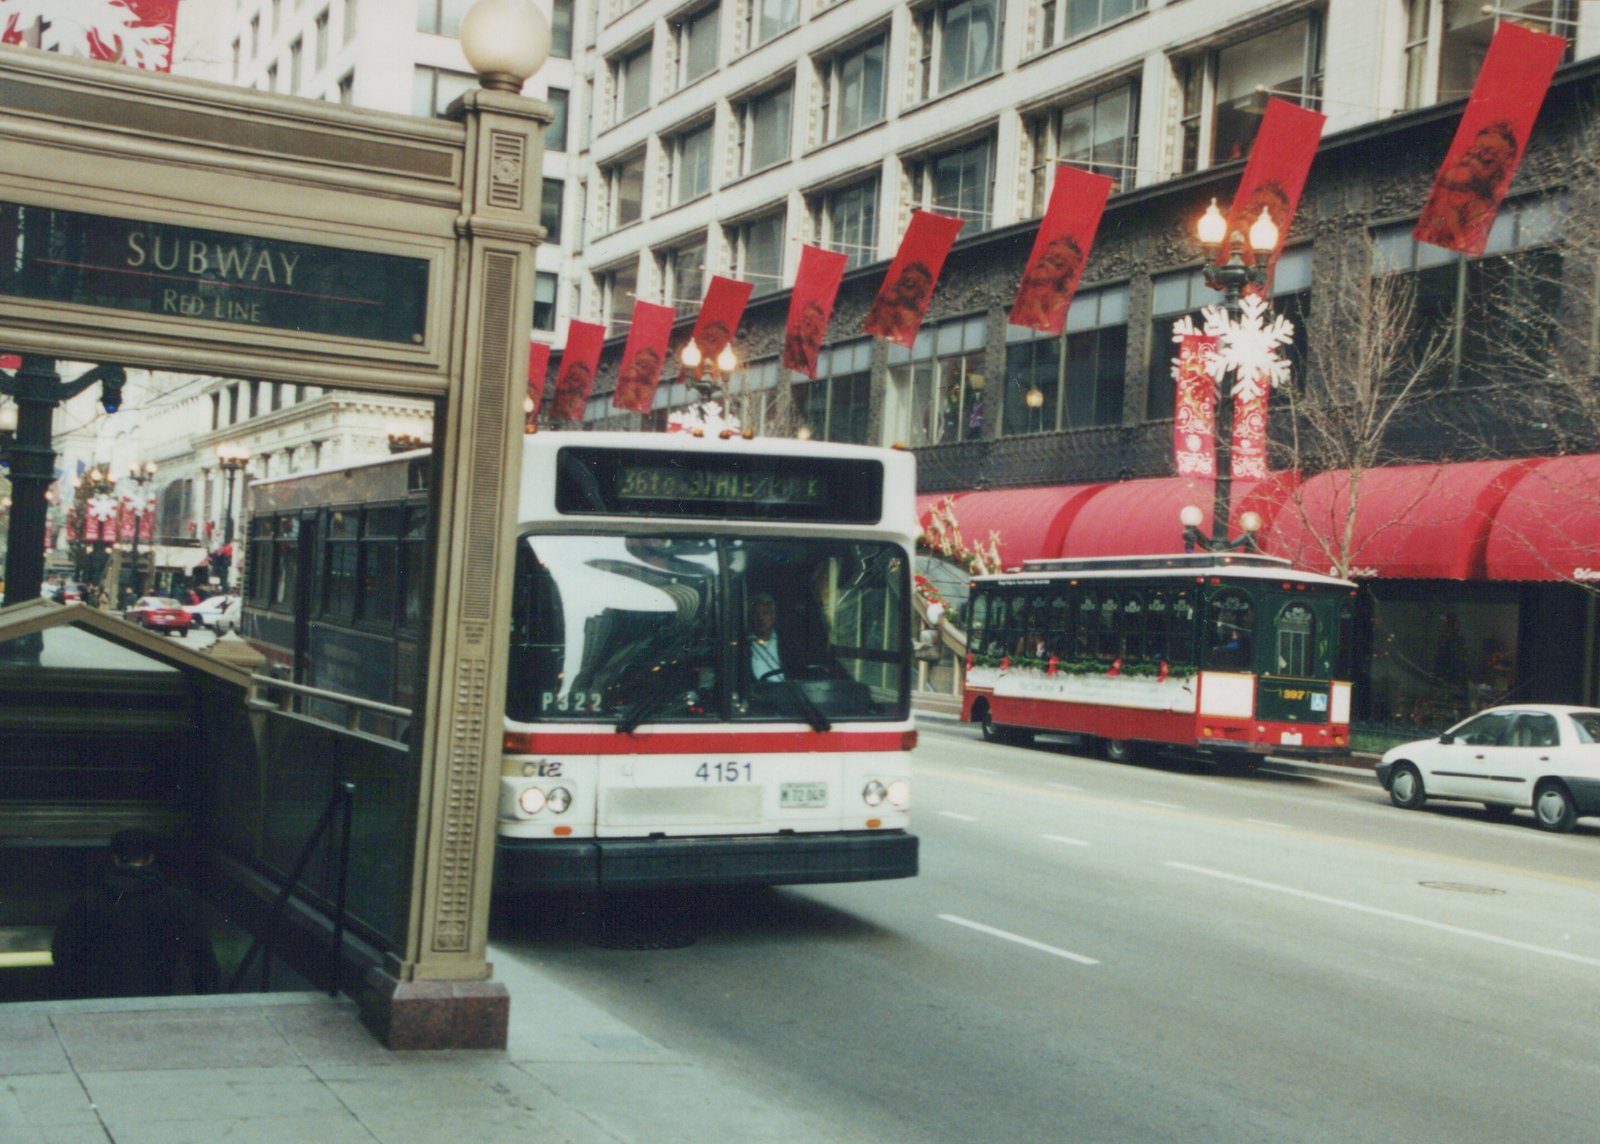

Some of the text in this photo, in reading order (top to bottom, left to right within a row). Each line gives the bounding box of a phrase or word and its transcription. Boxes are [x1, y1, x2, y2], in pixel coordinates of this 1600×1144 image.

[127, 233, 299, 286] SUBWAY
[163, 289, 261, 322] RED LINE
[542, 691, 602, 712] P322
[695, 761, 752, 783] 4151
